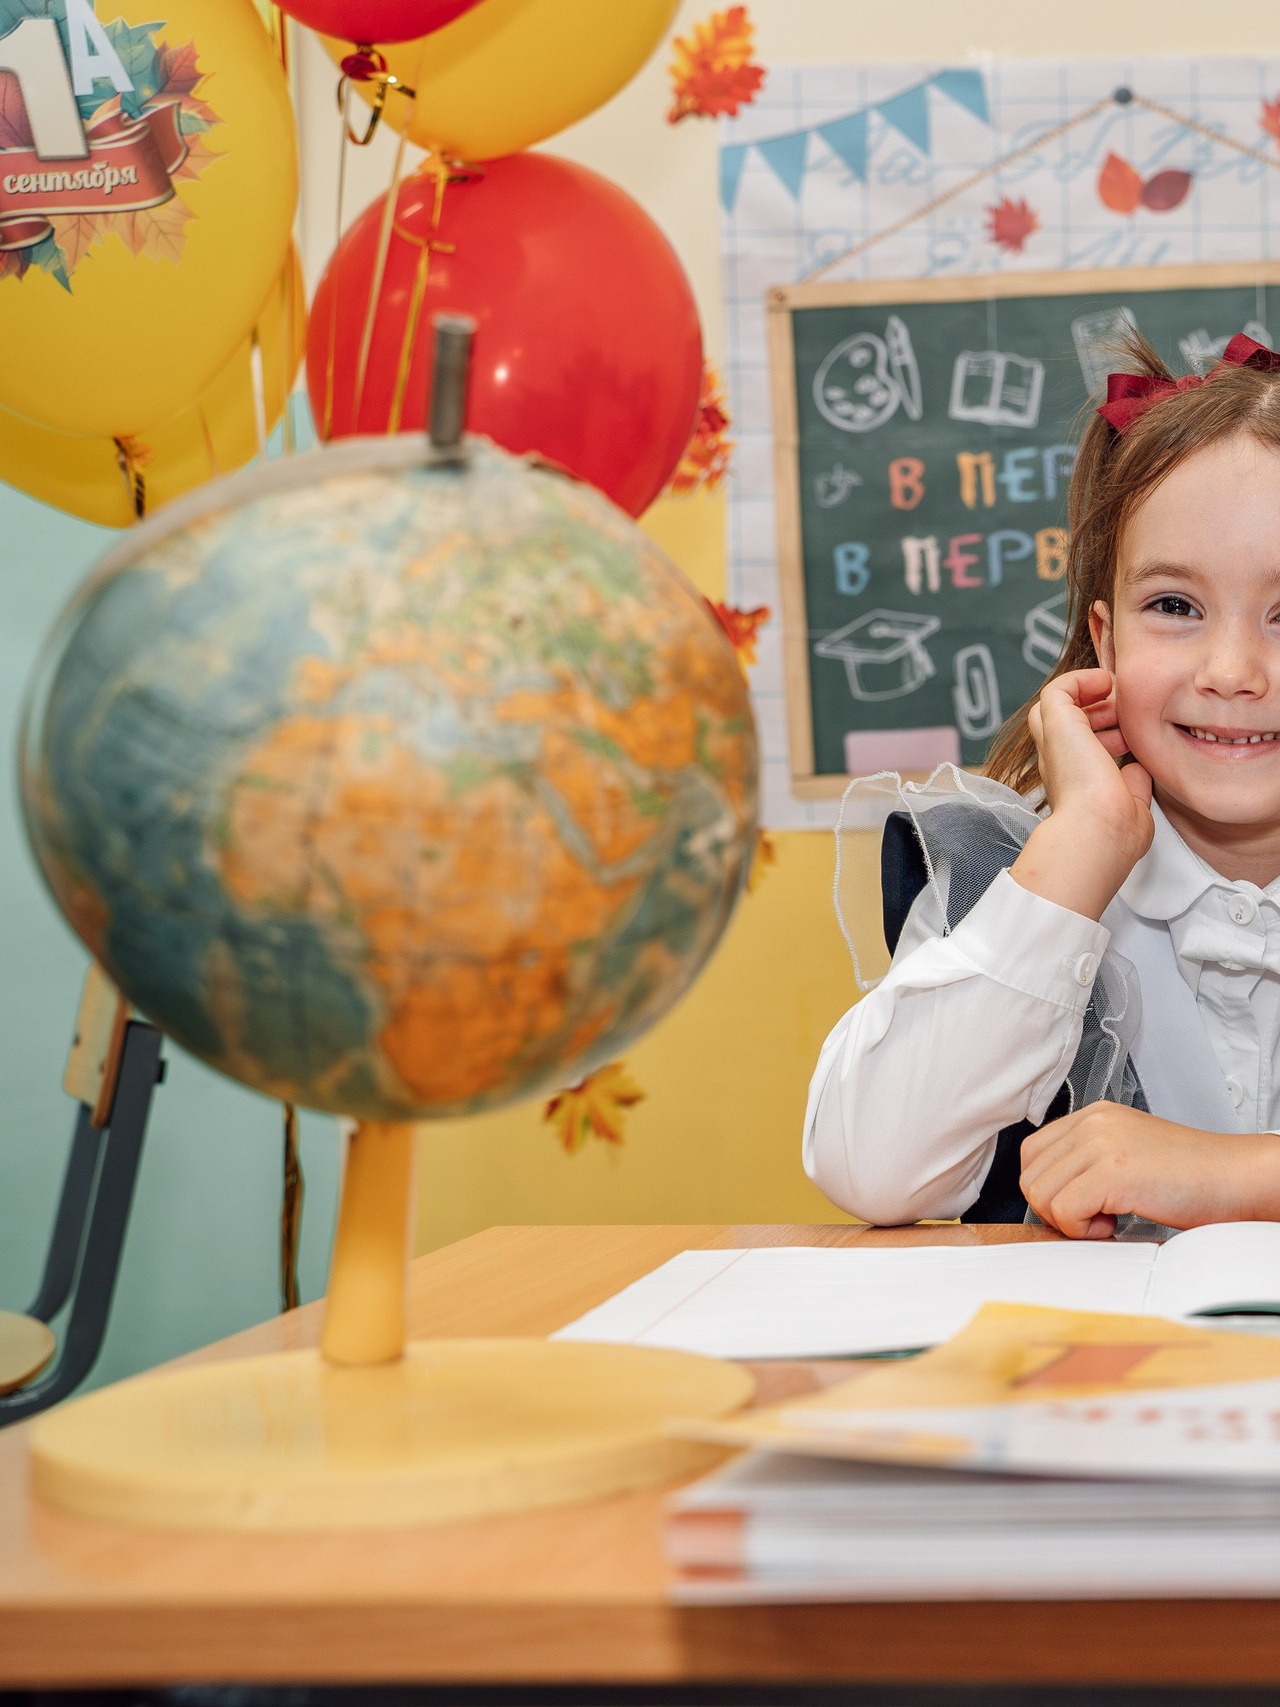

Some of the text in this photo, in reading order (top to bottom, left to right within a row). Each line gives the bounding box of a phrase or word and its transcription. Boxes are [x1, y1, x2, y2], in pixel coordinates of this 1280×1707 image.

[3, 160, 139, 195] сентября
[888, 456, 925, 511] В
[833, 542, 871, 596] В
